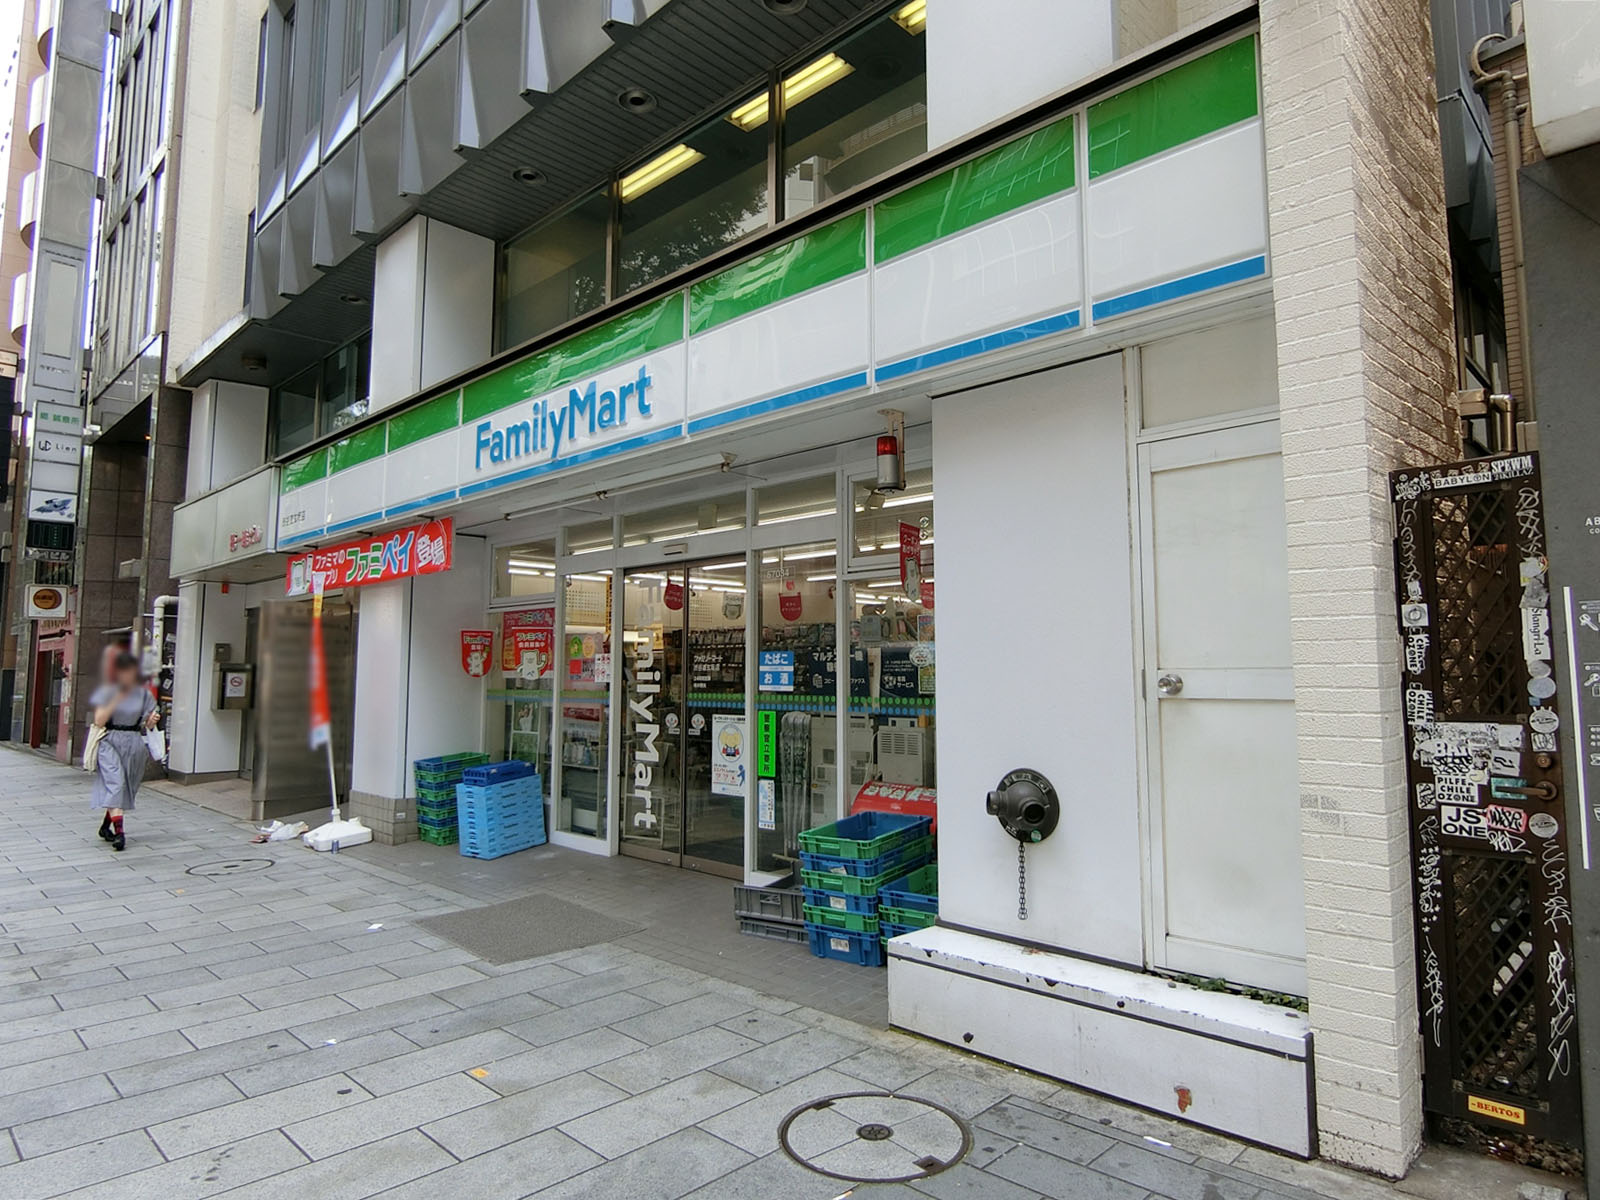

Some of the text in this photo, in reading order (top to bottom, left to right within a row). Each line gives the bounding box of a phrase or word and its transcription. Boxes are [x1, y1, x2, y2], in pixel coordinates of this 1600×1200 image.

[476, 364, 652, 462] FamilyMart
[1491, 455, 1533, 474] SPEWM
[315, 549, 345, 570] ファミマの
[345, 530, 415, 583] ファミペイ
[416, 534, 446, 567] 登場
[516, 632, 547, 641] ファミペイ
[764, 653, 789, 665] たばこ
[764, 672, 789, 685] お酒
[629, 578, 661, 829] FamilyMart
[1416, 694, 1425, 720] CHILE
[1437, 793, 1475, 802] OZONE
[1440, 785, 1471, 793] CHILE
[1447, 807, 1482, 825] JS
[1443, 823, 1488, 838] ONE
